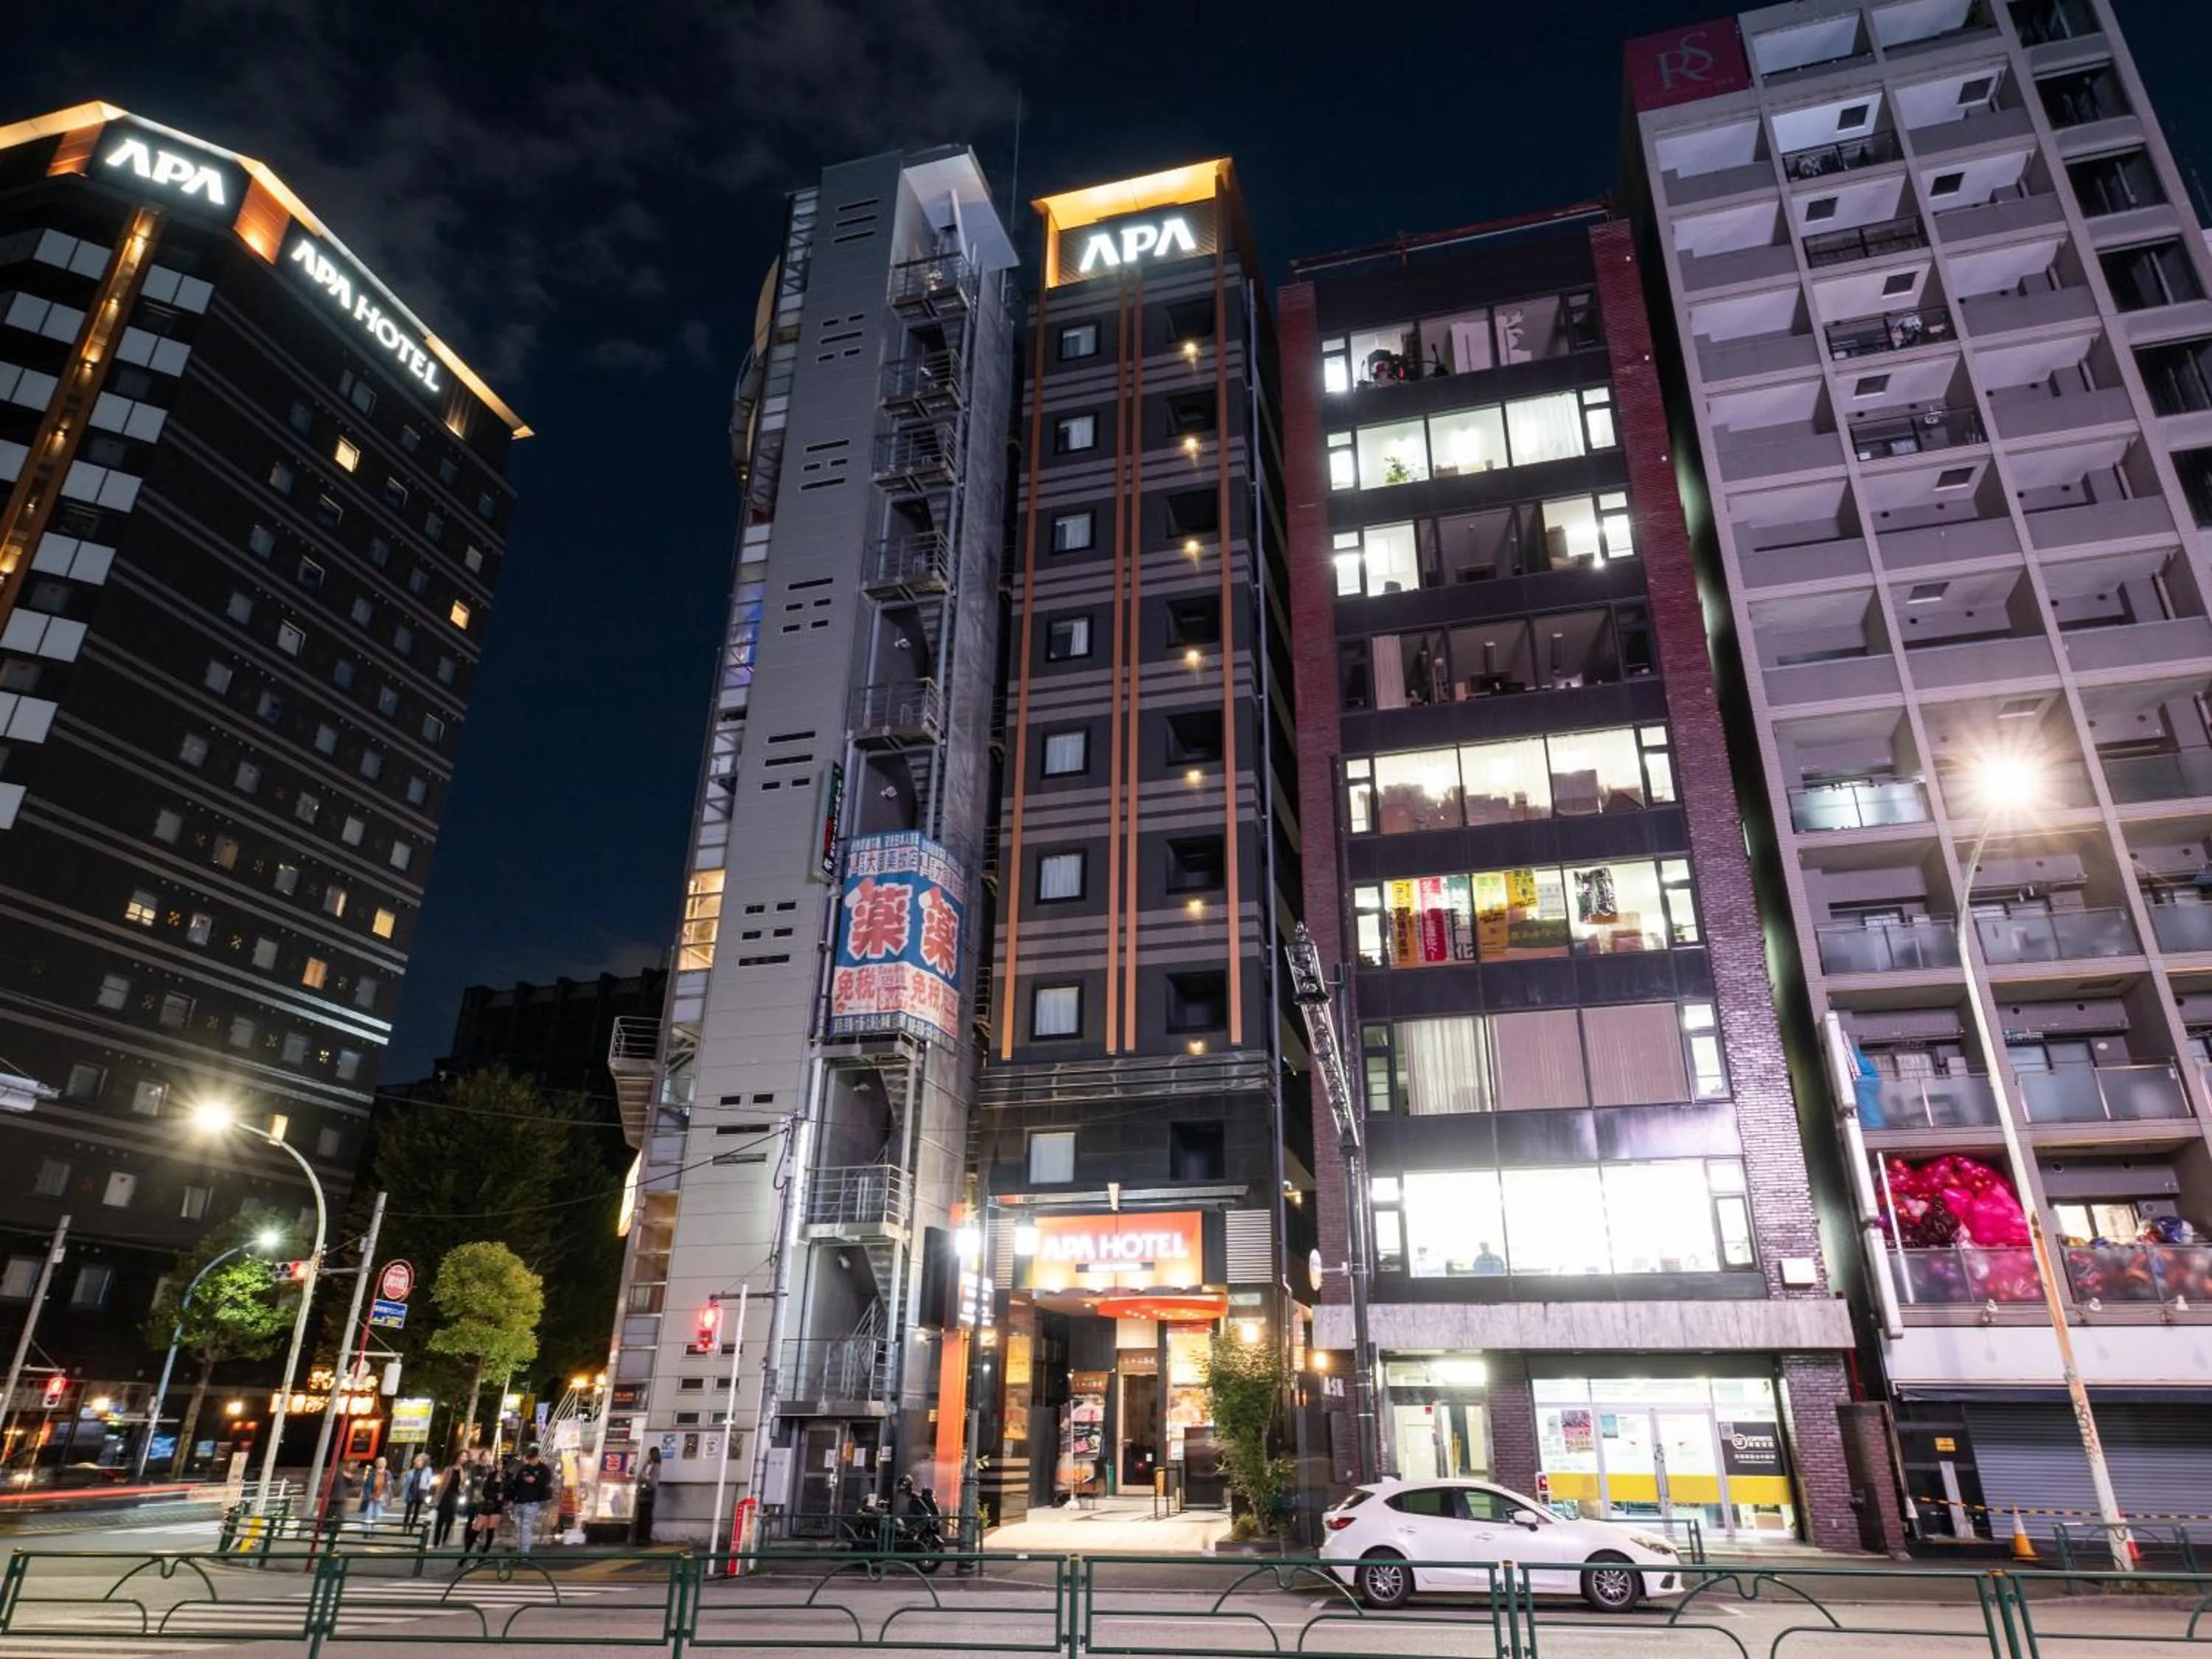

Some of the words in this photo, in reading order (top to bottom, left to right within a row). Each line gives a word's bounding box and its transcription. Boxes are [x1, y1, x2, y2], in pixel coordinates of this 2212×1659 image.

[105, 139, 225, 205] APA
[1079, 218, 1197, 274] APA
[291, 240, 352, 309] APA
[353, 295, 439, 392] HOTEL
[1043, 1235, 1097, 1260] APA
[1099, 1232, 1189, 1260] HOTEL
